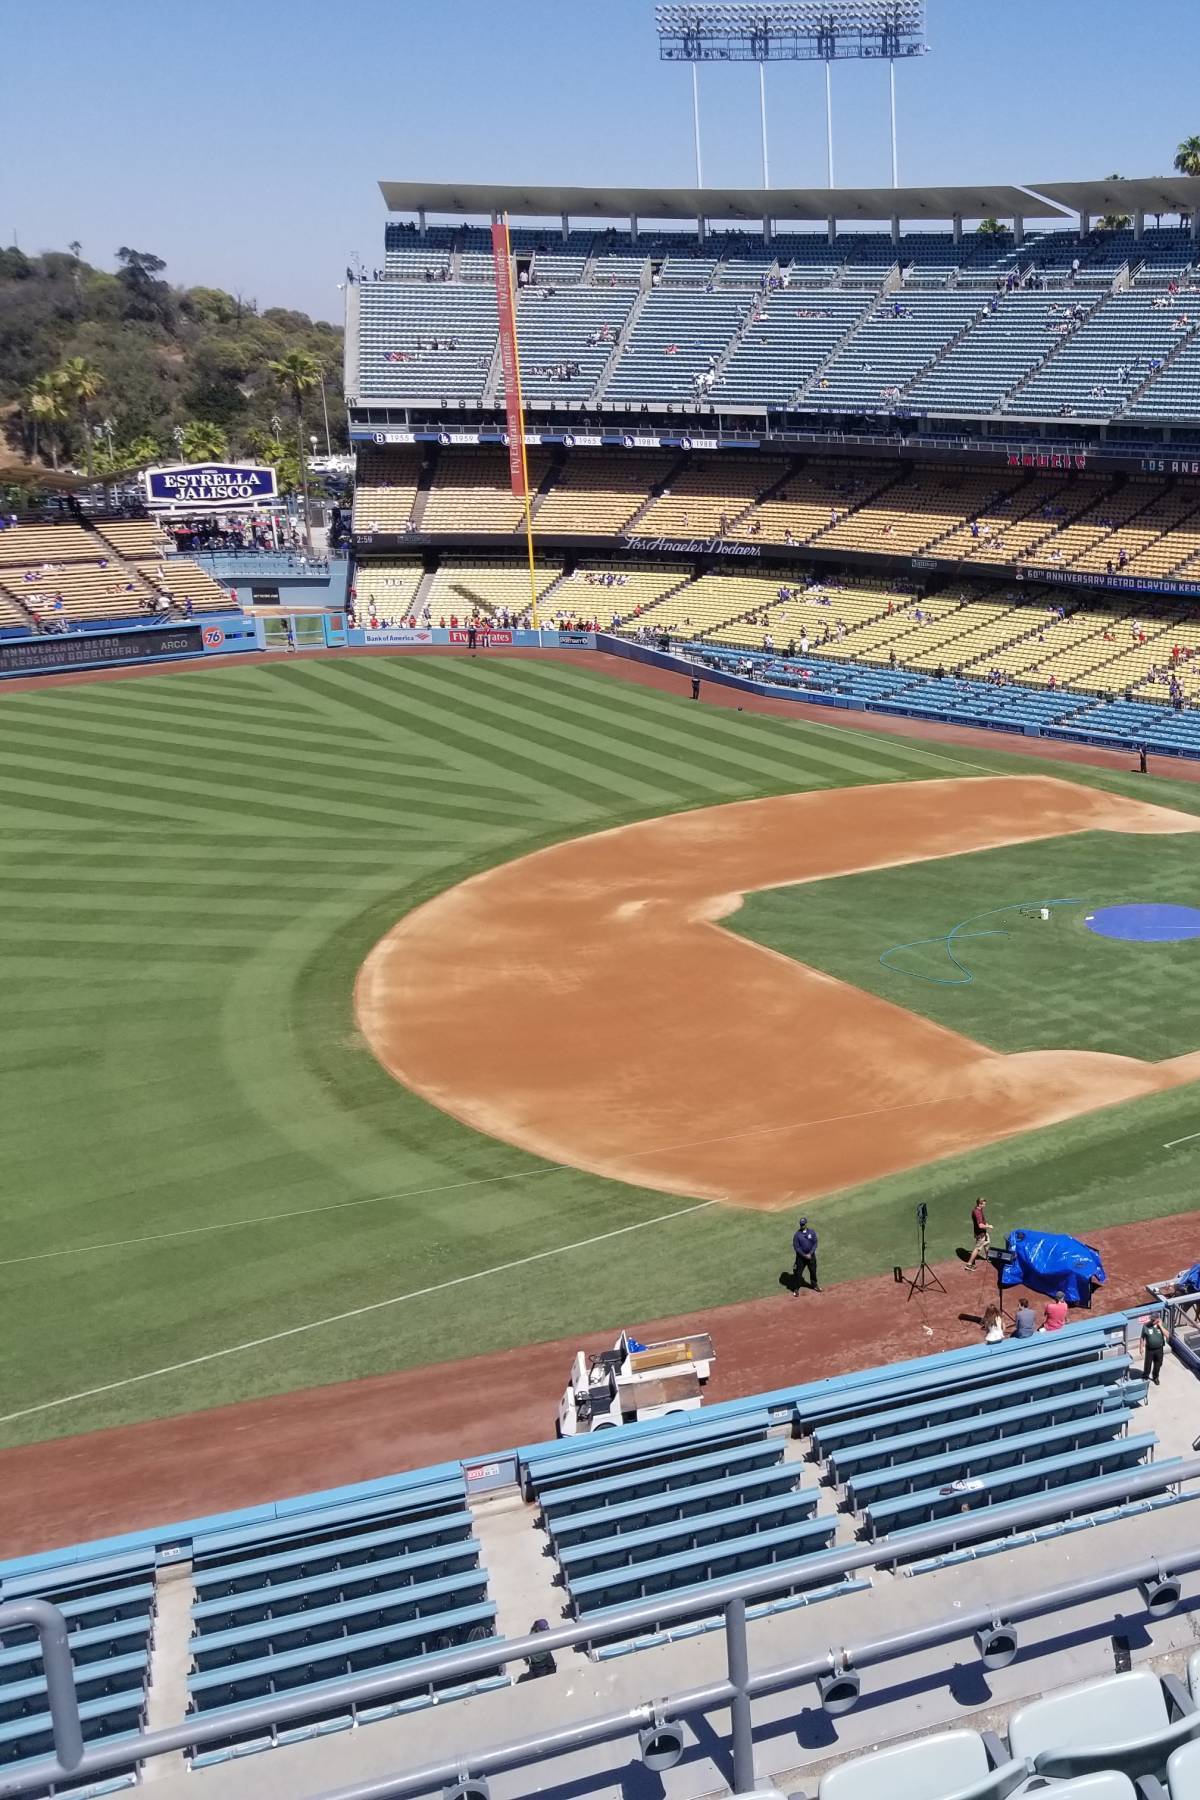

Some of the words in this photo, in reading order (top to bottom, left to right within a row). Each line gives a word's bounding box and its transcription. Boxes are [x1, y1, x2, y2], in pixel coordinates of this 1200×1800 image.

[502, 332, 512, 371] Emirates
[505, 376, 514, 393] Fly
[550, 401, 649, 413] STADIUM
[666, 403, 715, 414] CLUB
[390, 434, 410, 442] 1955
[509, 414, 519, 455] Emirates
[511, 457, 520, 474] Fly
[1141, 460, 1165, 472] LOS
[163, 473, 261, 488] ESTRELLA
[175, 485, 252, 500] JALISCO
[620, 536, 647, 549] Los
[647, 537, 702, 553] Angeles
[704, 539, 761, 556] Dodgers
[1046, 571, 1105, 585] ANNIVERSARY
[1107, 576, 1135, 588] RETRO
[1136, 579, 1177, 592] CLAYTON
[160, 639, 188, 650] ARCO
[452, 632, 468, 642] Fly
